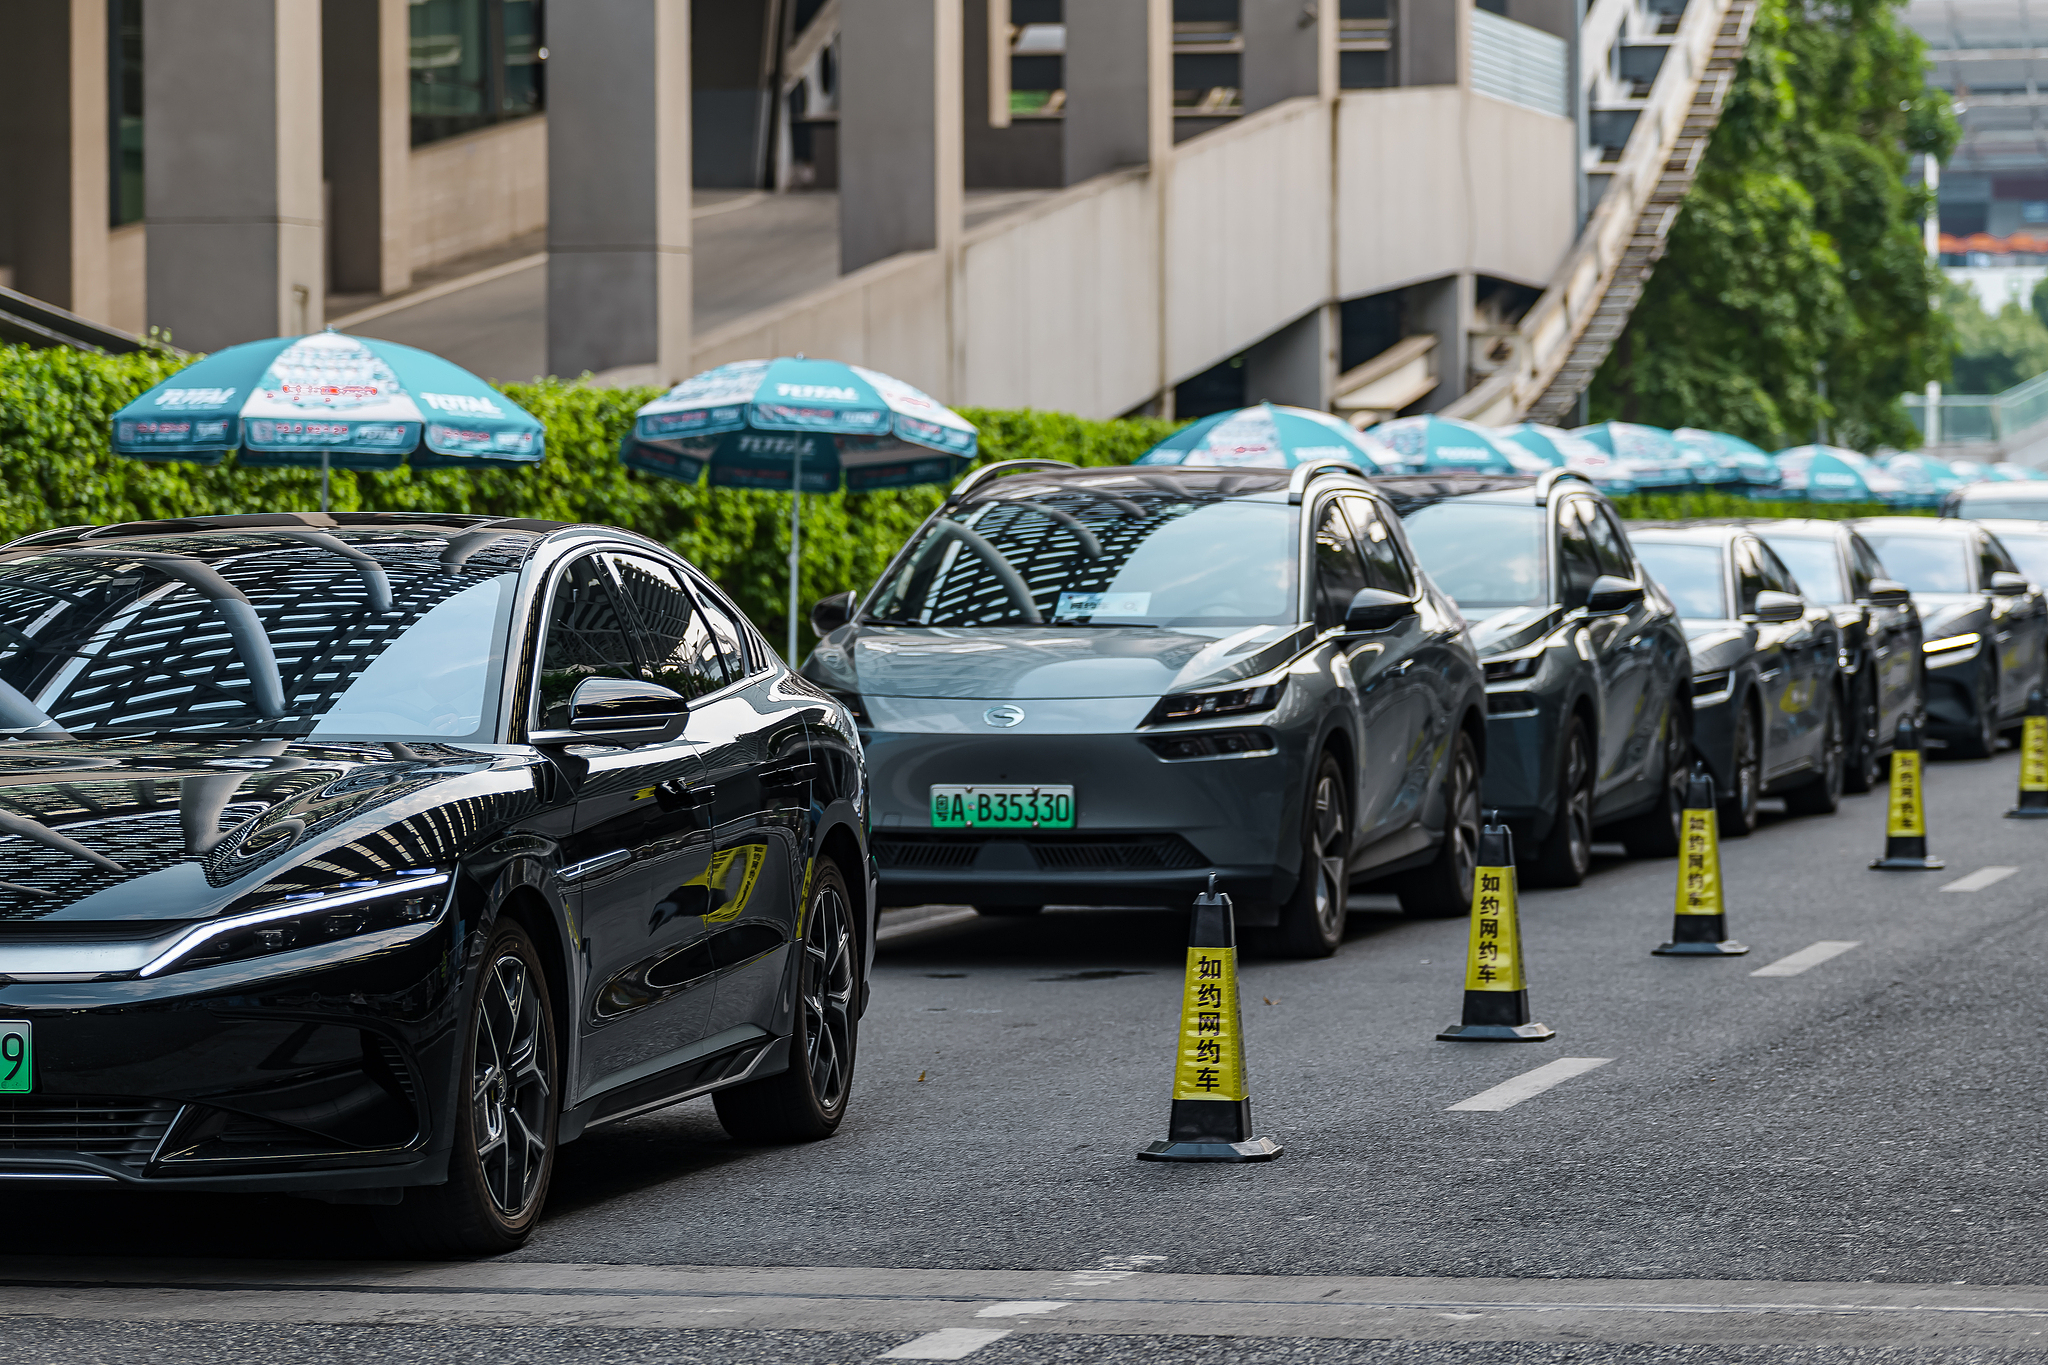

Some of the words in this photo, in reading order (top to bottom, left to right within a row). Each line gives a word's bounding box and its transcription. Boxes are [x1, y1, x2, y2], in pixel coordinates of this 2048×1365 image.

[1477, 873, 1500, 984] 如约网约车
[1195, 955, 1222, 1093] 如约网约车
